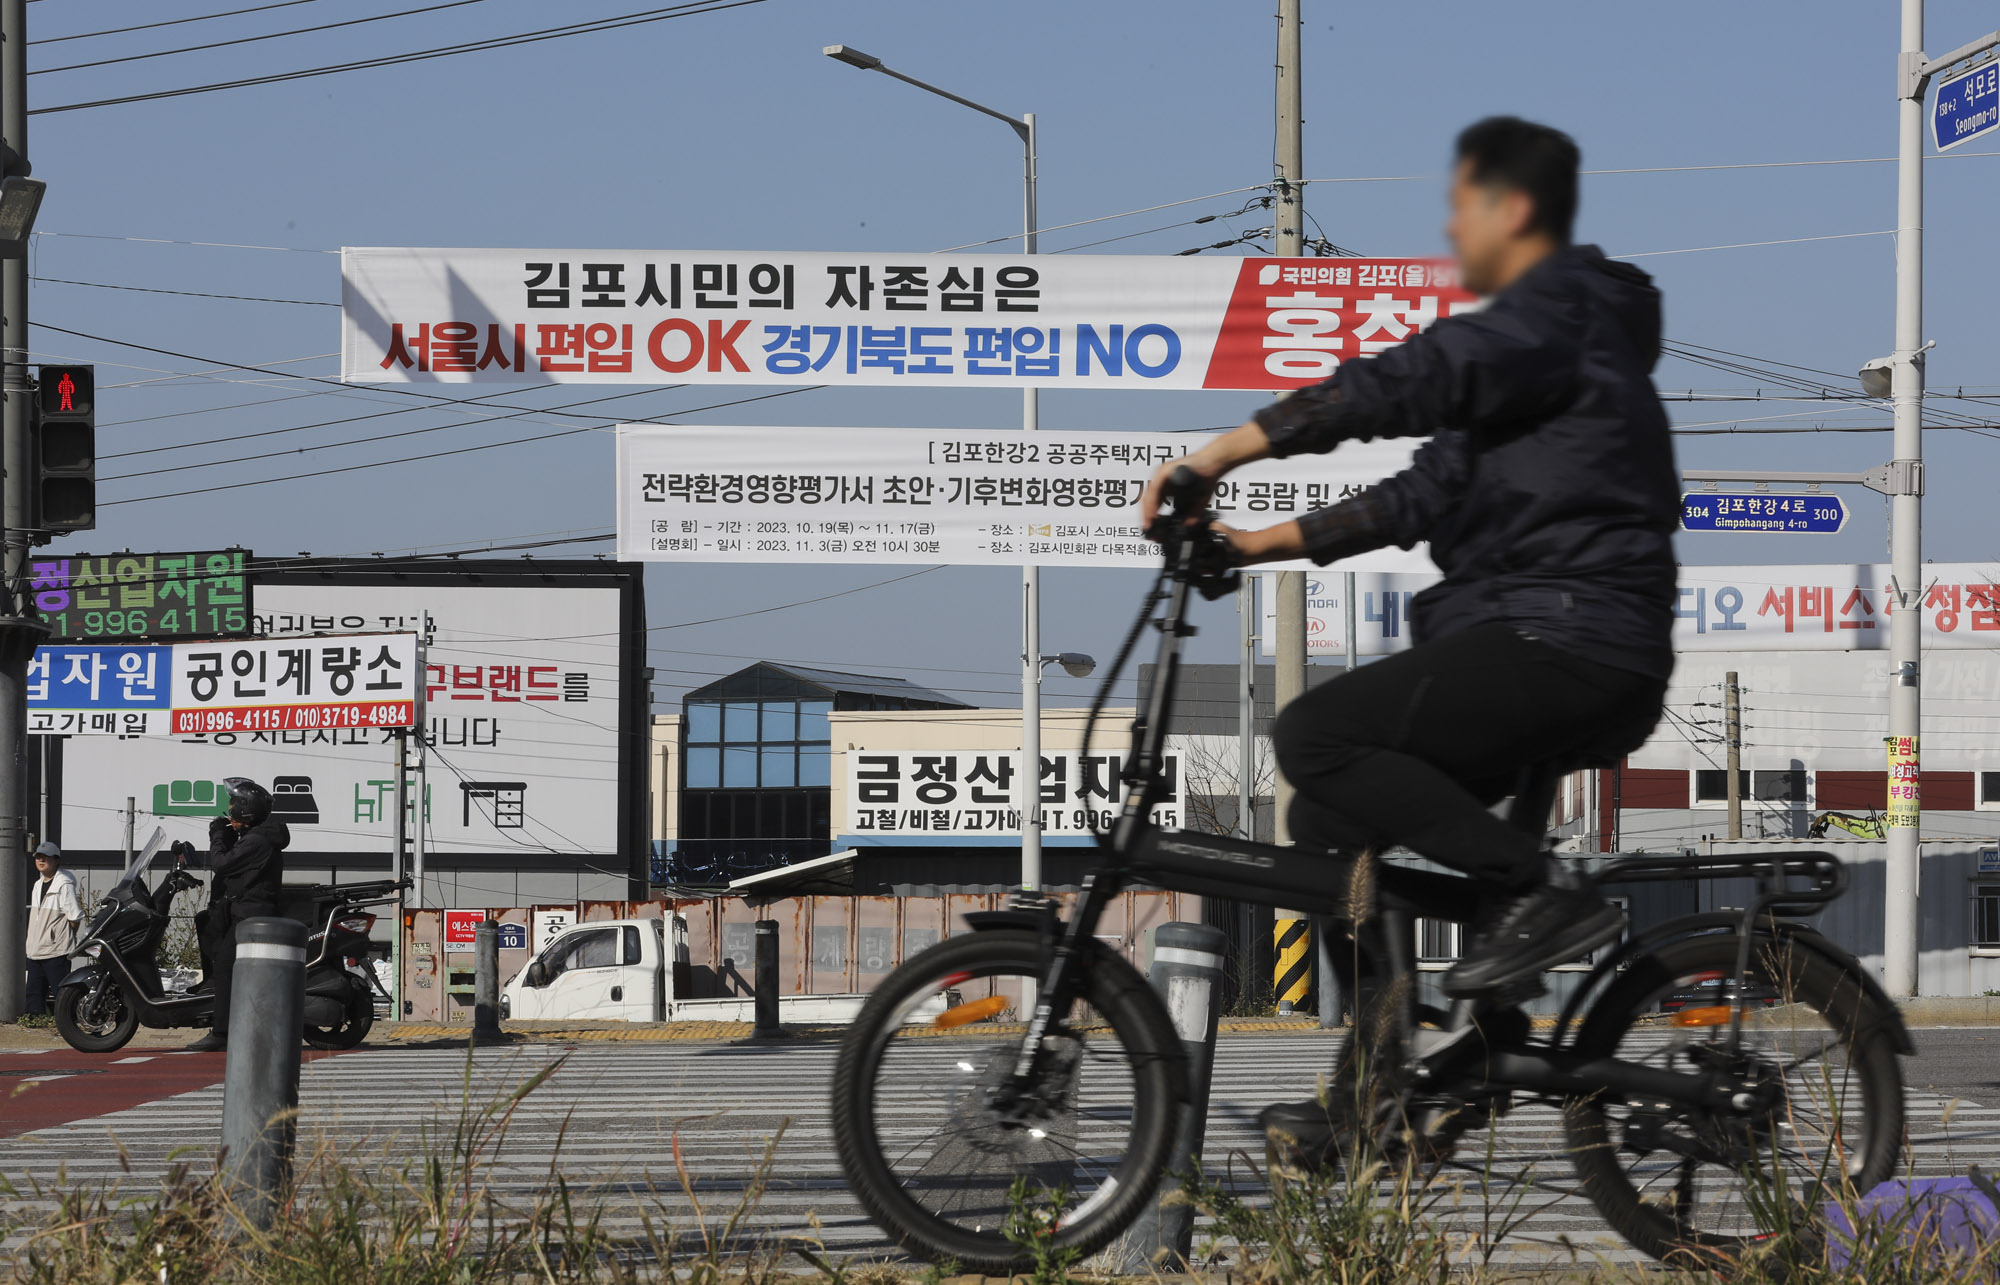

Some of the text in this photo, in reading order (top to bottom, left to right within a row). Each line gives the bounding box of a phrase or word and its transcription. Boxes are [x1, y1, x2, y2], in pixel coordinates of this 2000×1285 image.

[1964, 69, 1997, 107] 석모로
[1955, 106, 1997, 136] Seongmo-ro
[524, 263, 1041, 313] 김포시민의 자존심은
[1283, 267, 1351, 286] 국민의힘
[1262, 290, 1486, 379] 홍철
[380, 318, 1182, 379] 서울시 편입 OK 경기북도 편입 NO
[942, 441, 1040, 464] 김포한강2
[1047, 444, 1175, 466] 공공주택지구
[642, 473, 874, 505] 전략환경영향평가서
[1247, 482, 1299, 512] 공람
[1685, 506, 1709, 519] 304
[1813, 508, 1838, 521] 300
[1715, 517, 1808, 530] Gimpohangang 4-ro
[717, 521, 742, 534] 기간
[757, 523, 791, 534] 2023.
[796, 523, 814, 534] 10.
[819, 521, 854, 536] 19(목)
[876, 524, 894, 535] 11.
[900, 522, 936, 536] 17(금)
[990, 524, 1014, 537] 장소
[1056, 525, 1090, 538] 김포시
[1094, 526, 1146, 538] 스마트도
[651, 538, 698, 552] [설명회]
[717, 540, 742, 552] 일시
[757, 541, 791, 552] 2023.
[796, 541, 814, 552] 11.
[819, 540, 848, 553] 3(금)
[852, 540, 877, 553] 오전
[882, 541, 909, 553] 10시
[914, 541, 941, 554] 30분
[990, 541, 1014, 554] 장소
[1029, 542, 1098, 555] 김포시민회관
[1307, 639, 1339, 648] OTORS
[187, 646, 403, 702] 공인계량소
[28, 713, 148, 734] 고가매입
[503, 935, 518, 947] 10
